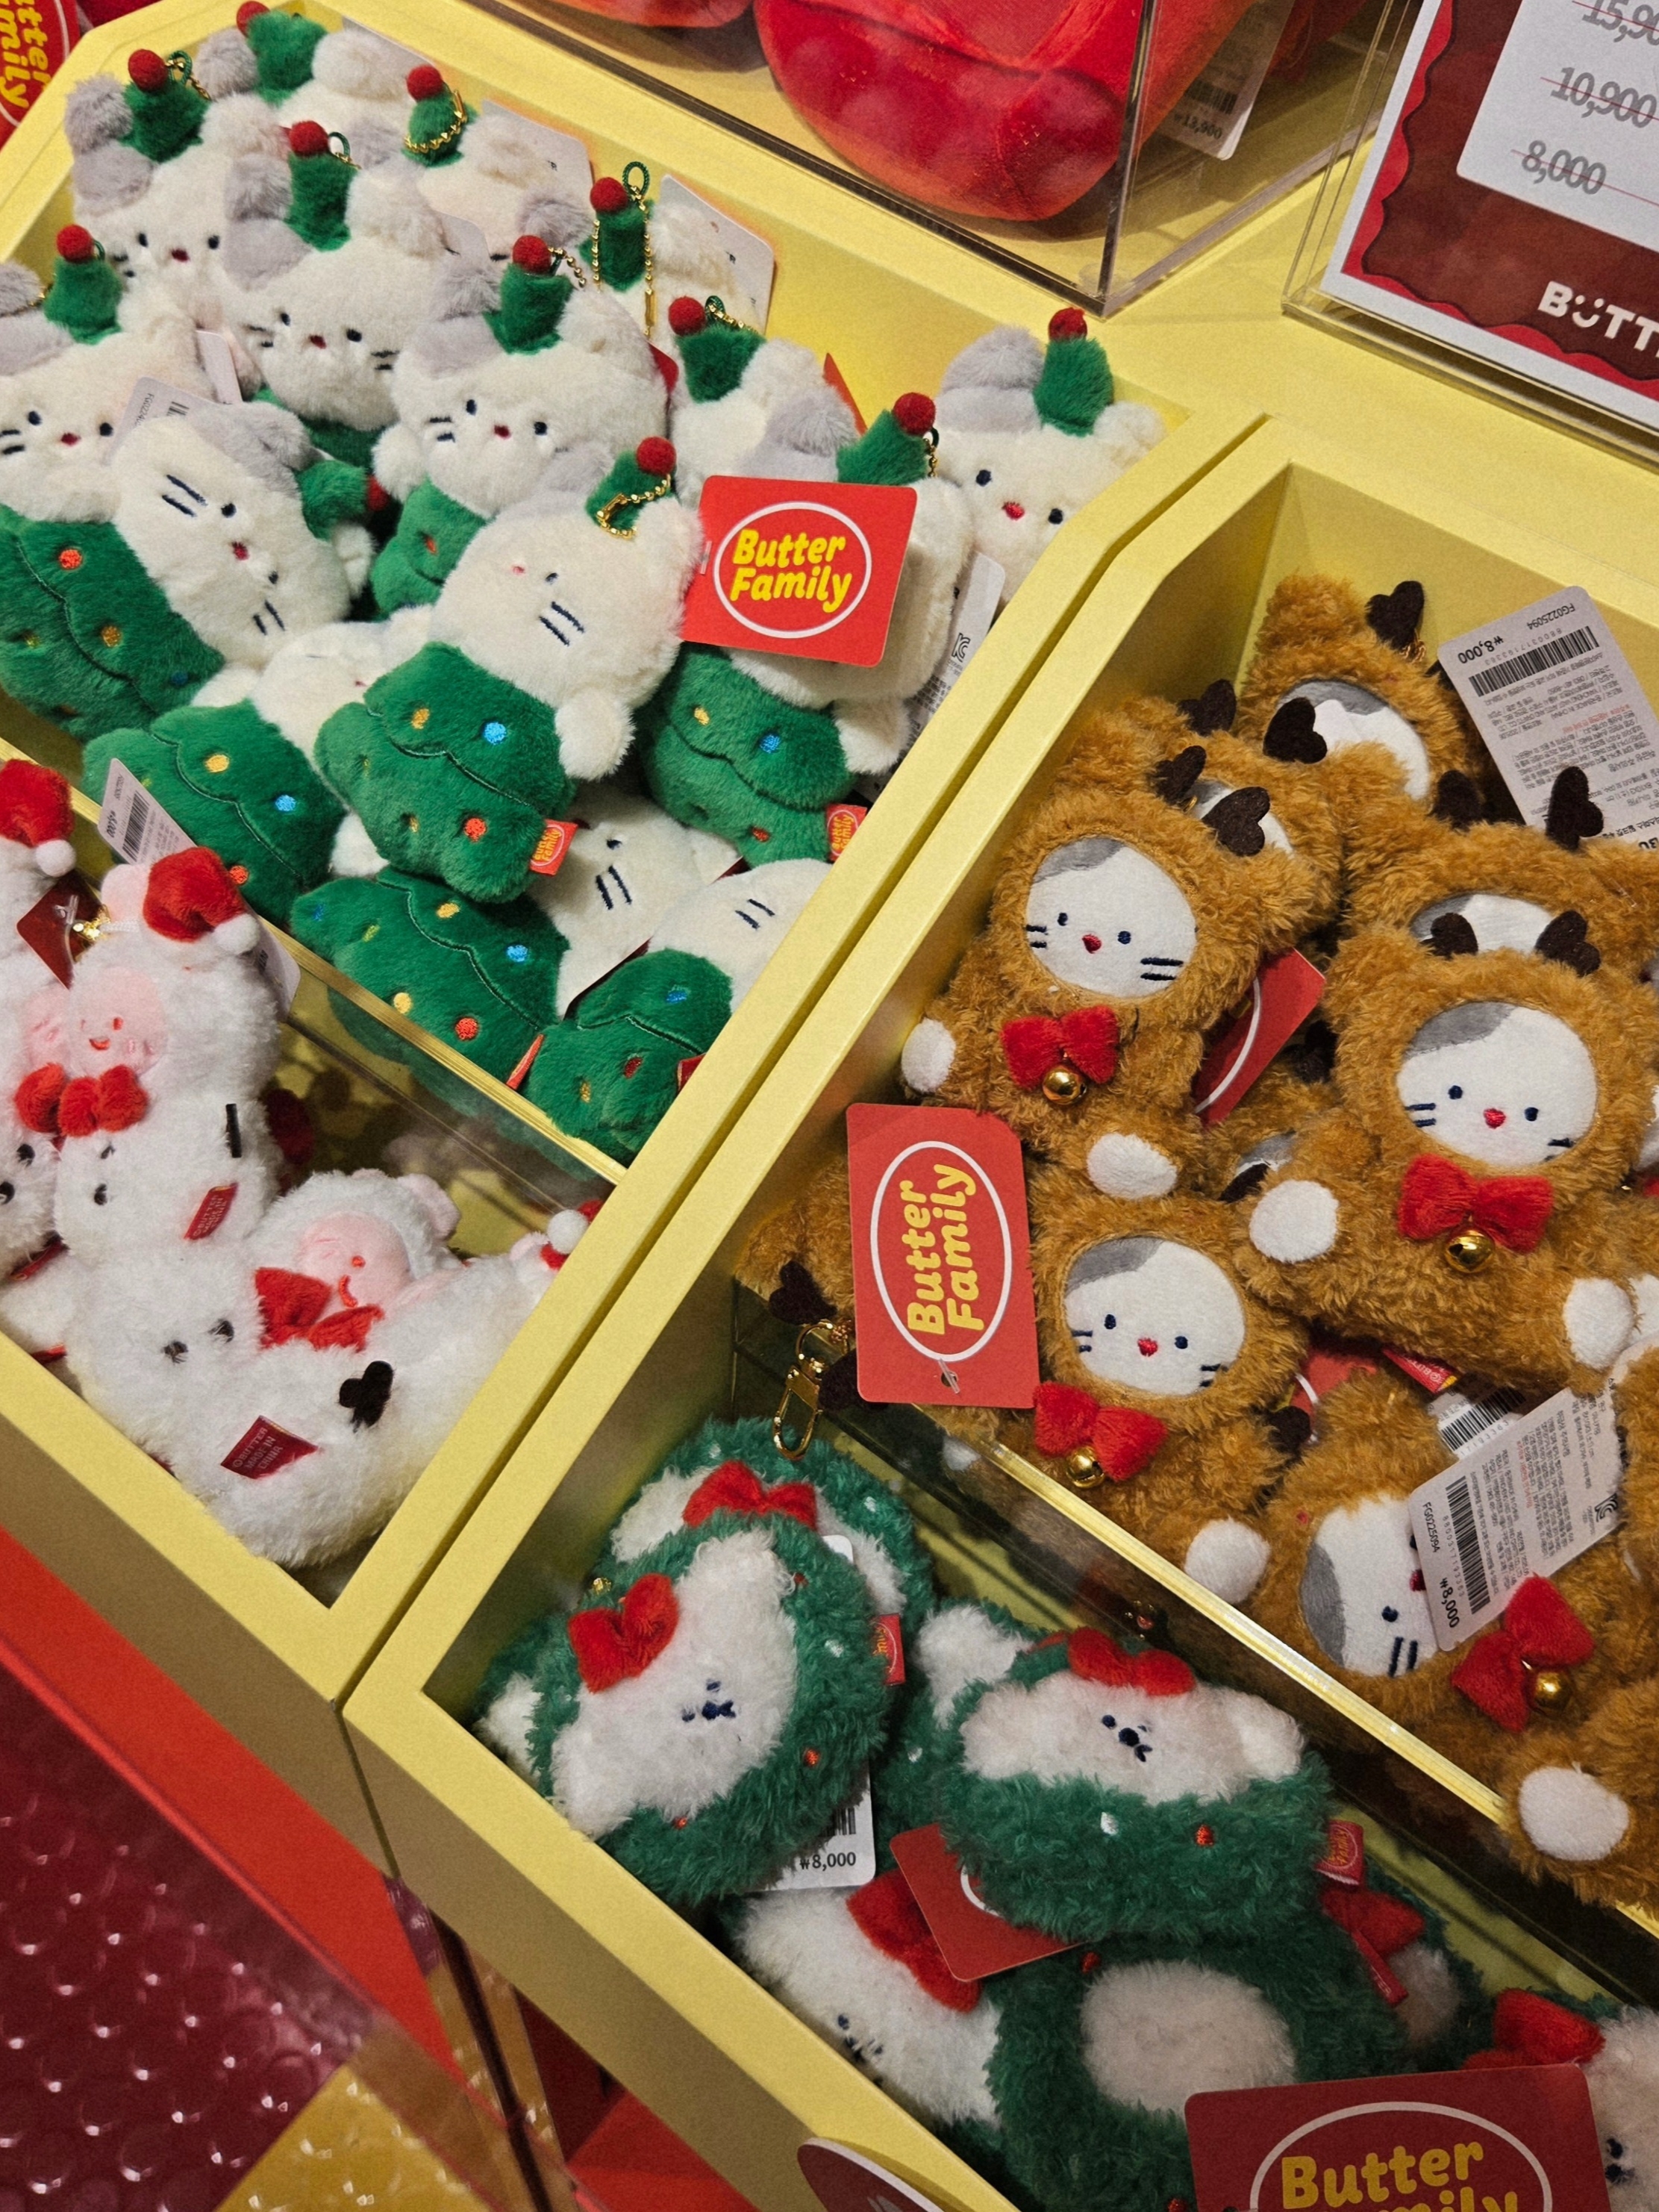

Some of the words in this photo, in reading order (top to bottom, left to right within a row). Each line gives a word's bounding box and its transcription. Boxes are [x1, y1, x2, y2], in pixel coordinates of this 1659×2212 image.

[15, 0, 52, 93] tter
[1581, 0, 1659, 46] 15,90
[0, 0, 31, 108] mily
[1550, 67, 1658, 128] 10,900
[1521, 140, 1607, 195] 8,000
[134, 393, 155, 425] FG0224
[732, 528, 846, 569] Butter
[730, 565, 853, 613] Family
[1526, 602, 1576, 631] FG0225094
[1458, 634, 1504, 665] ₩8,000
[899, 1179, 946, 1336] Butter
[930, 1163, 985, 1331] Family
[1459, 1419, 1510, 1456] 17193363
[1422, 1502, 1441, 1554] FG0225094
[1440, 1577, 1460, 1629] ₩8,000
[799, 1851, 857, 1872] ₩8,000
[1281, 2141, 1484, 2210] Butter
